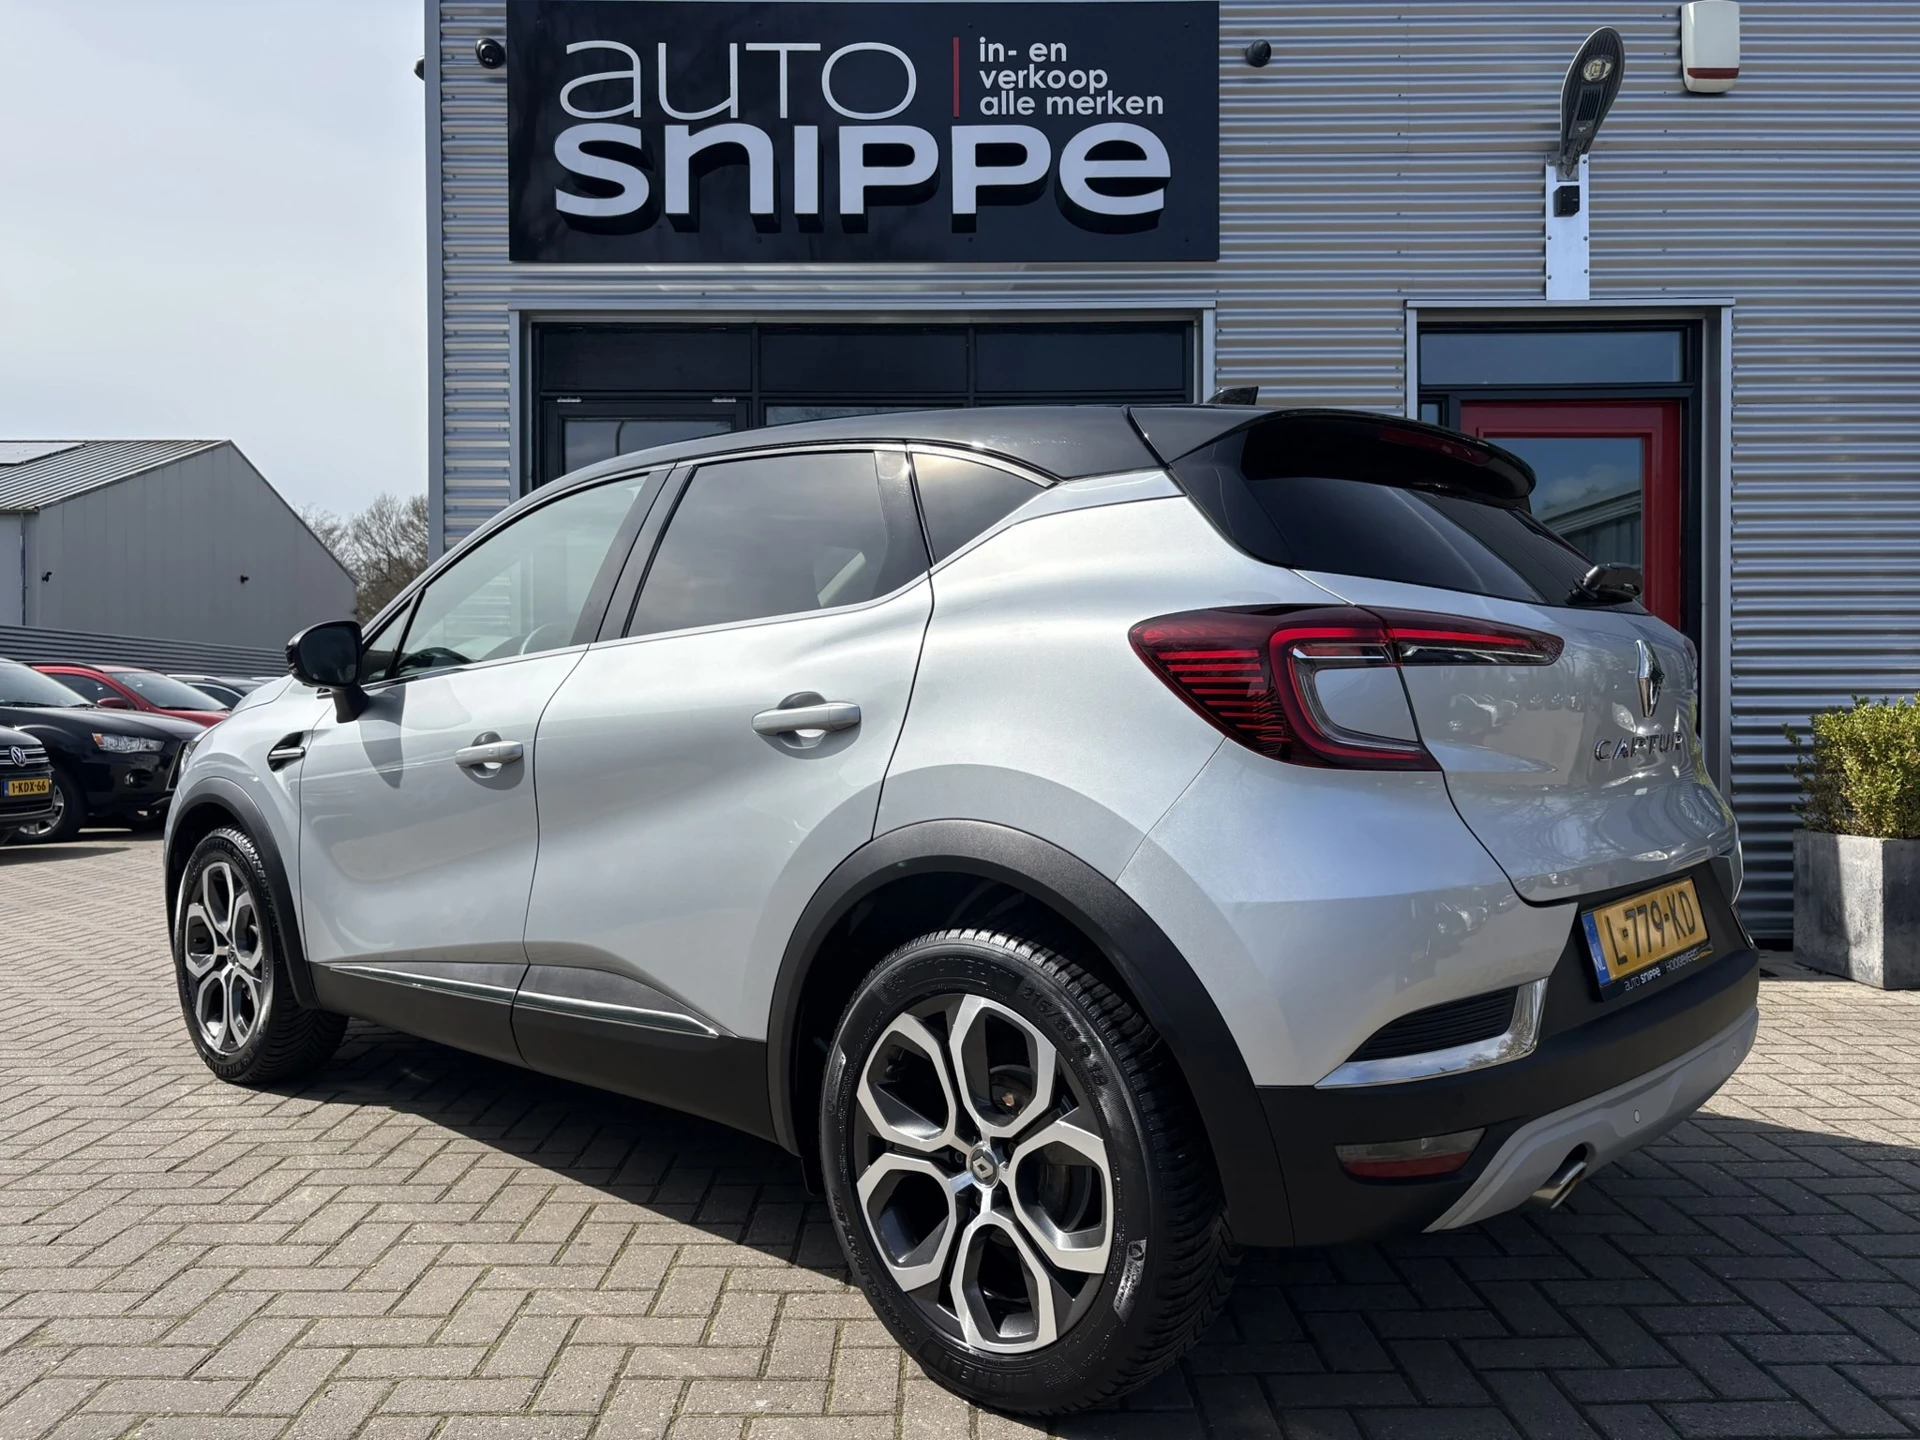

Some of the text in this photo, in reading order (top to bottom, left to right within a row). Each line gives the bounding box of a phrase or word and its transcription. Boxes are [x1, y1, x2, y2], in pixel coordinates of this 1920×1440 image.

[979, 36, 1067, 62] in- en
[979, 64, 1108, 95] verkoop
[979, 90, 1164, 115] alle merken
[1594, 732, 1683, 761] CAPTUR
[11, 780, 47, 794] 1-KDX-66
[1604, 890, 1697, 966] L-779-KD
